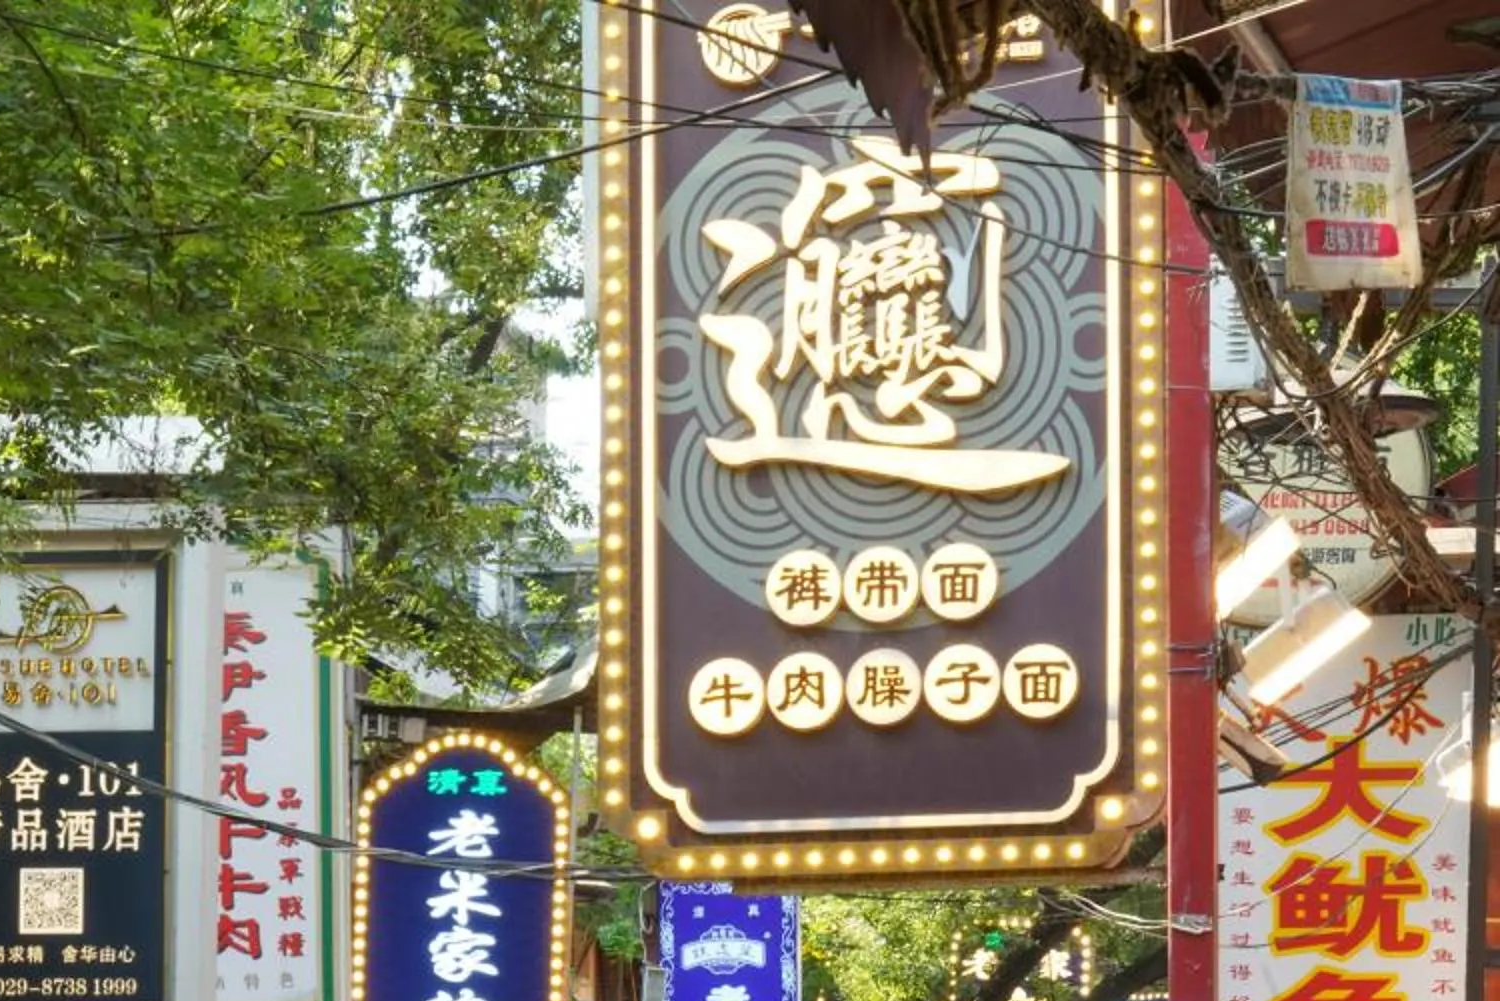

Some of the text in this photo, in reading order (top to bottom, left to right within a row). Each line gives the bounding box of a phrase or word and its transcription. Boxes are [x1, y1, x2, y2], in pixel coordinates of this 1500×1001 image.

[60, 657, 149, 675] HOTEL
[701, 661, 1070, 718] 牛肉臊子面
[93, 979, 137, 995] 1999
